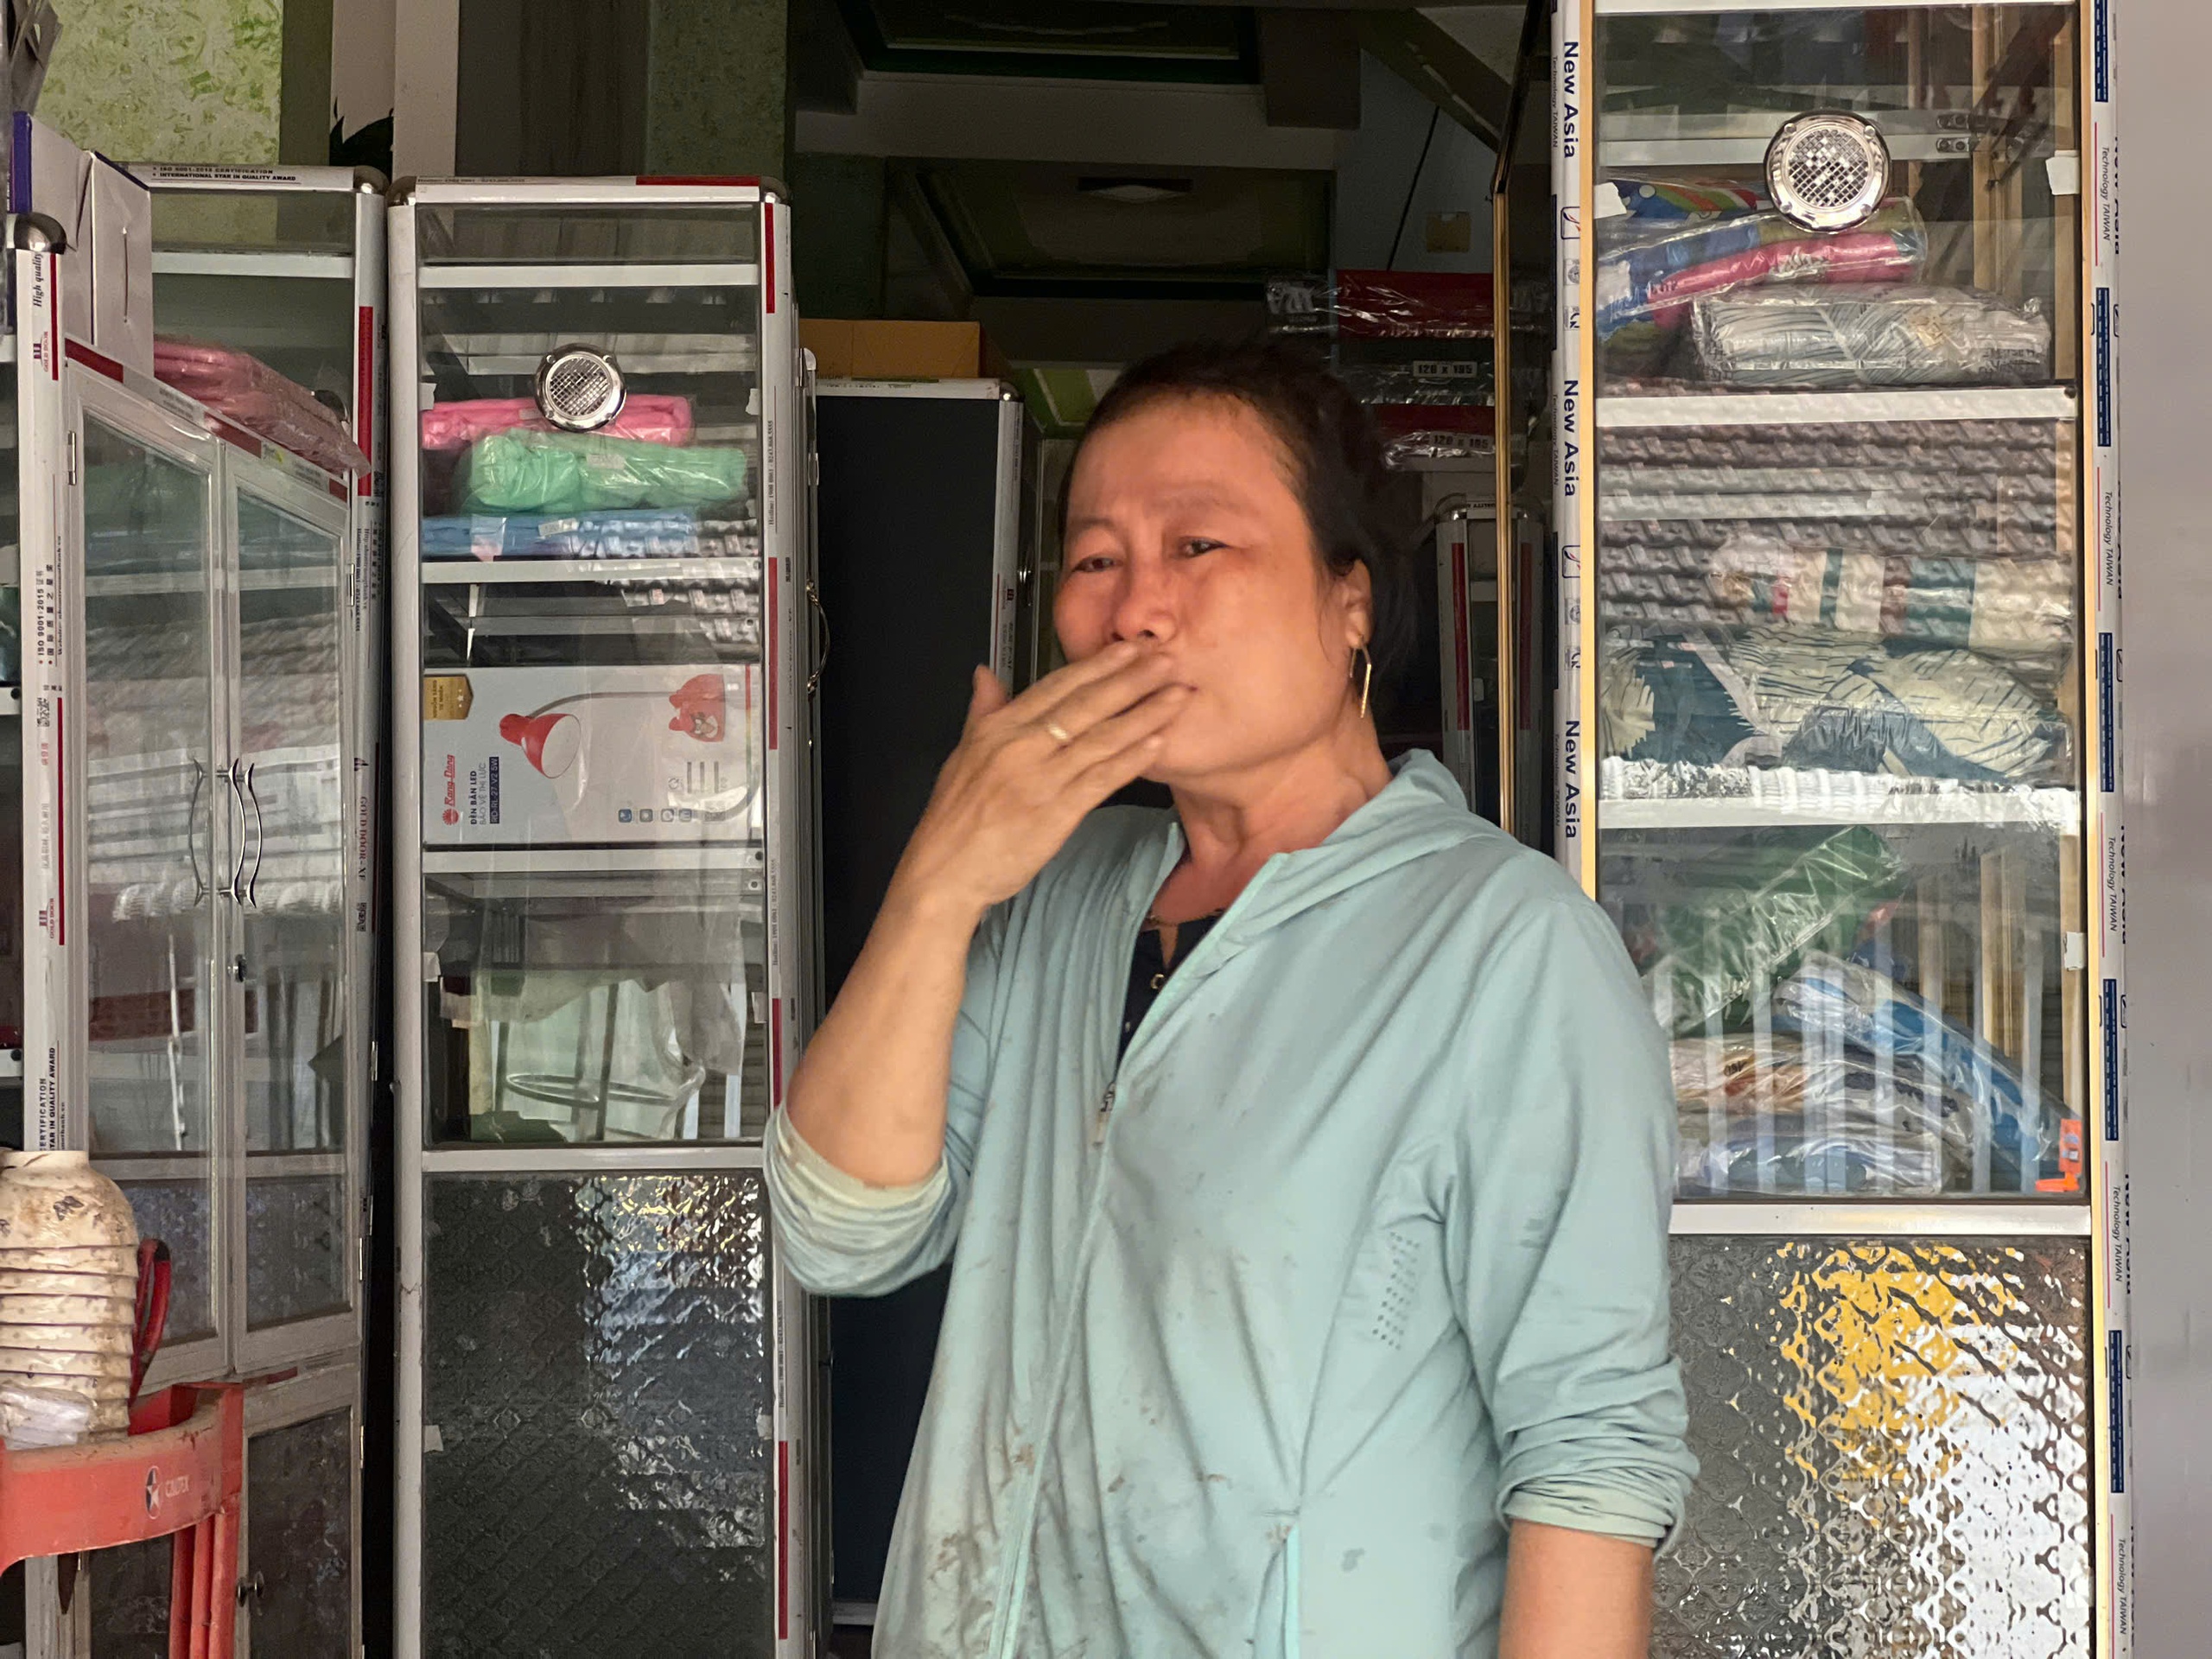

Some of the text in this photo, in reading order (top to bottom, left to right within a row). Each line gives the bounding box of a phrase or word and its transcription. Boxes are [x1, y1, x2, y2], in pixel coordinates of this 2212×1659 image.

[1564, 41, 1579, 158] New Asia
[2100, 146, 2111, 240] Technology TAIWAN
[32, 252, 44, 307] High quality
[1564, 380, 1579, 497] New Asia
[2103, 492, 2114, 585] Technology TAIWAN
[490, 758, 498, 772] 5W
[1565, 721, 1580, 839] New Asia
[2107, 836, 2118, 931] Technology TAIWAN
[49, 1121, 55, 1129] IN
[2112, 1185, 2123, 1281] Technology TAIWAN
[2117, 1538, 2126, 1593] Technology
